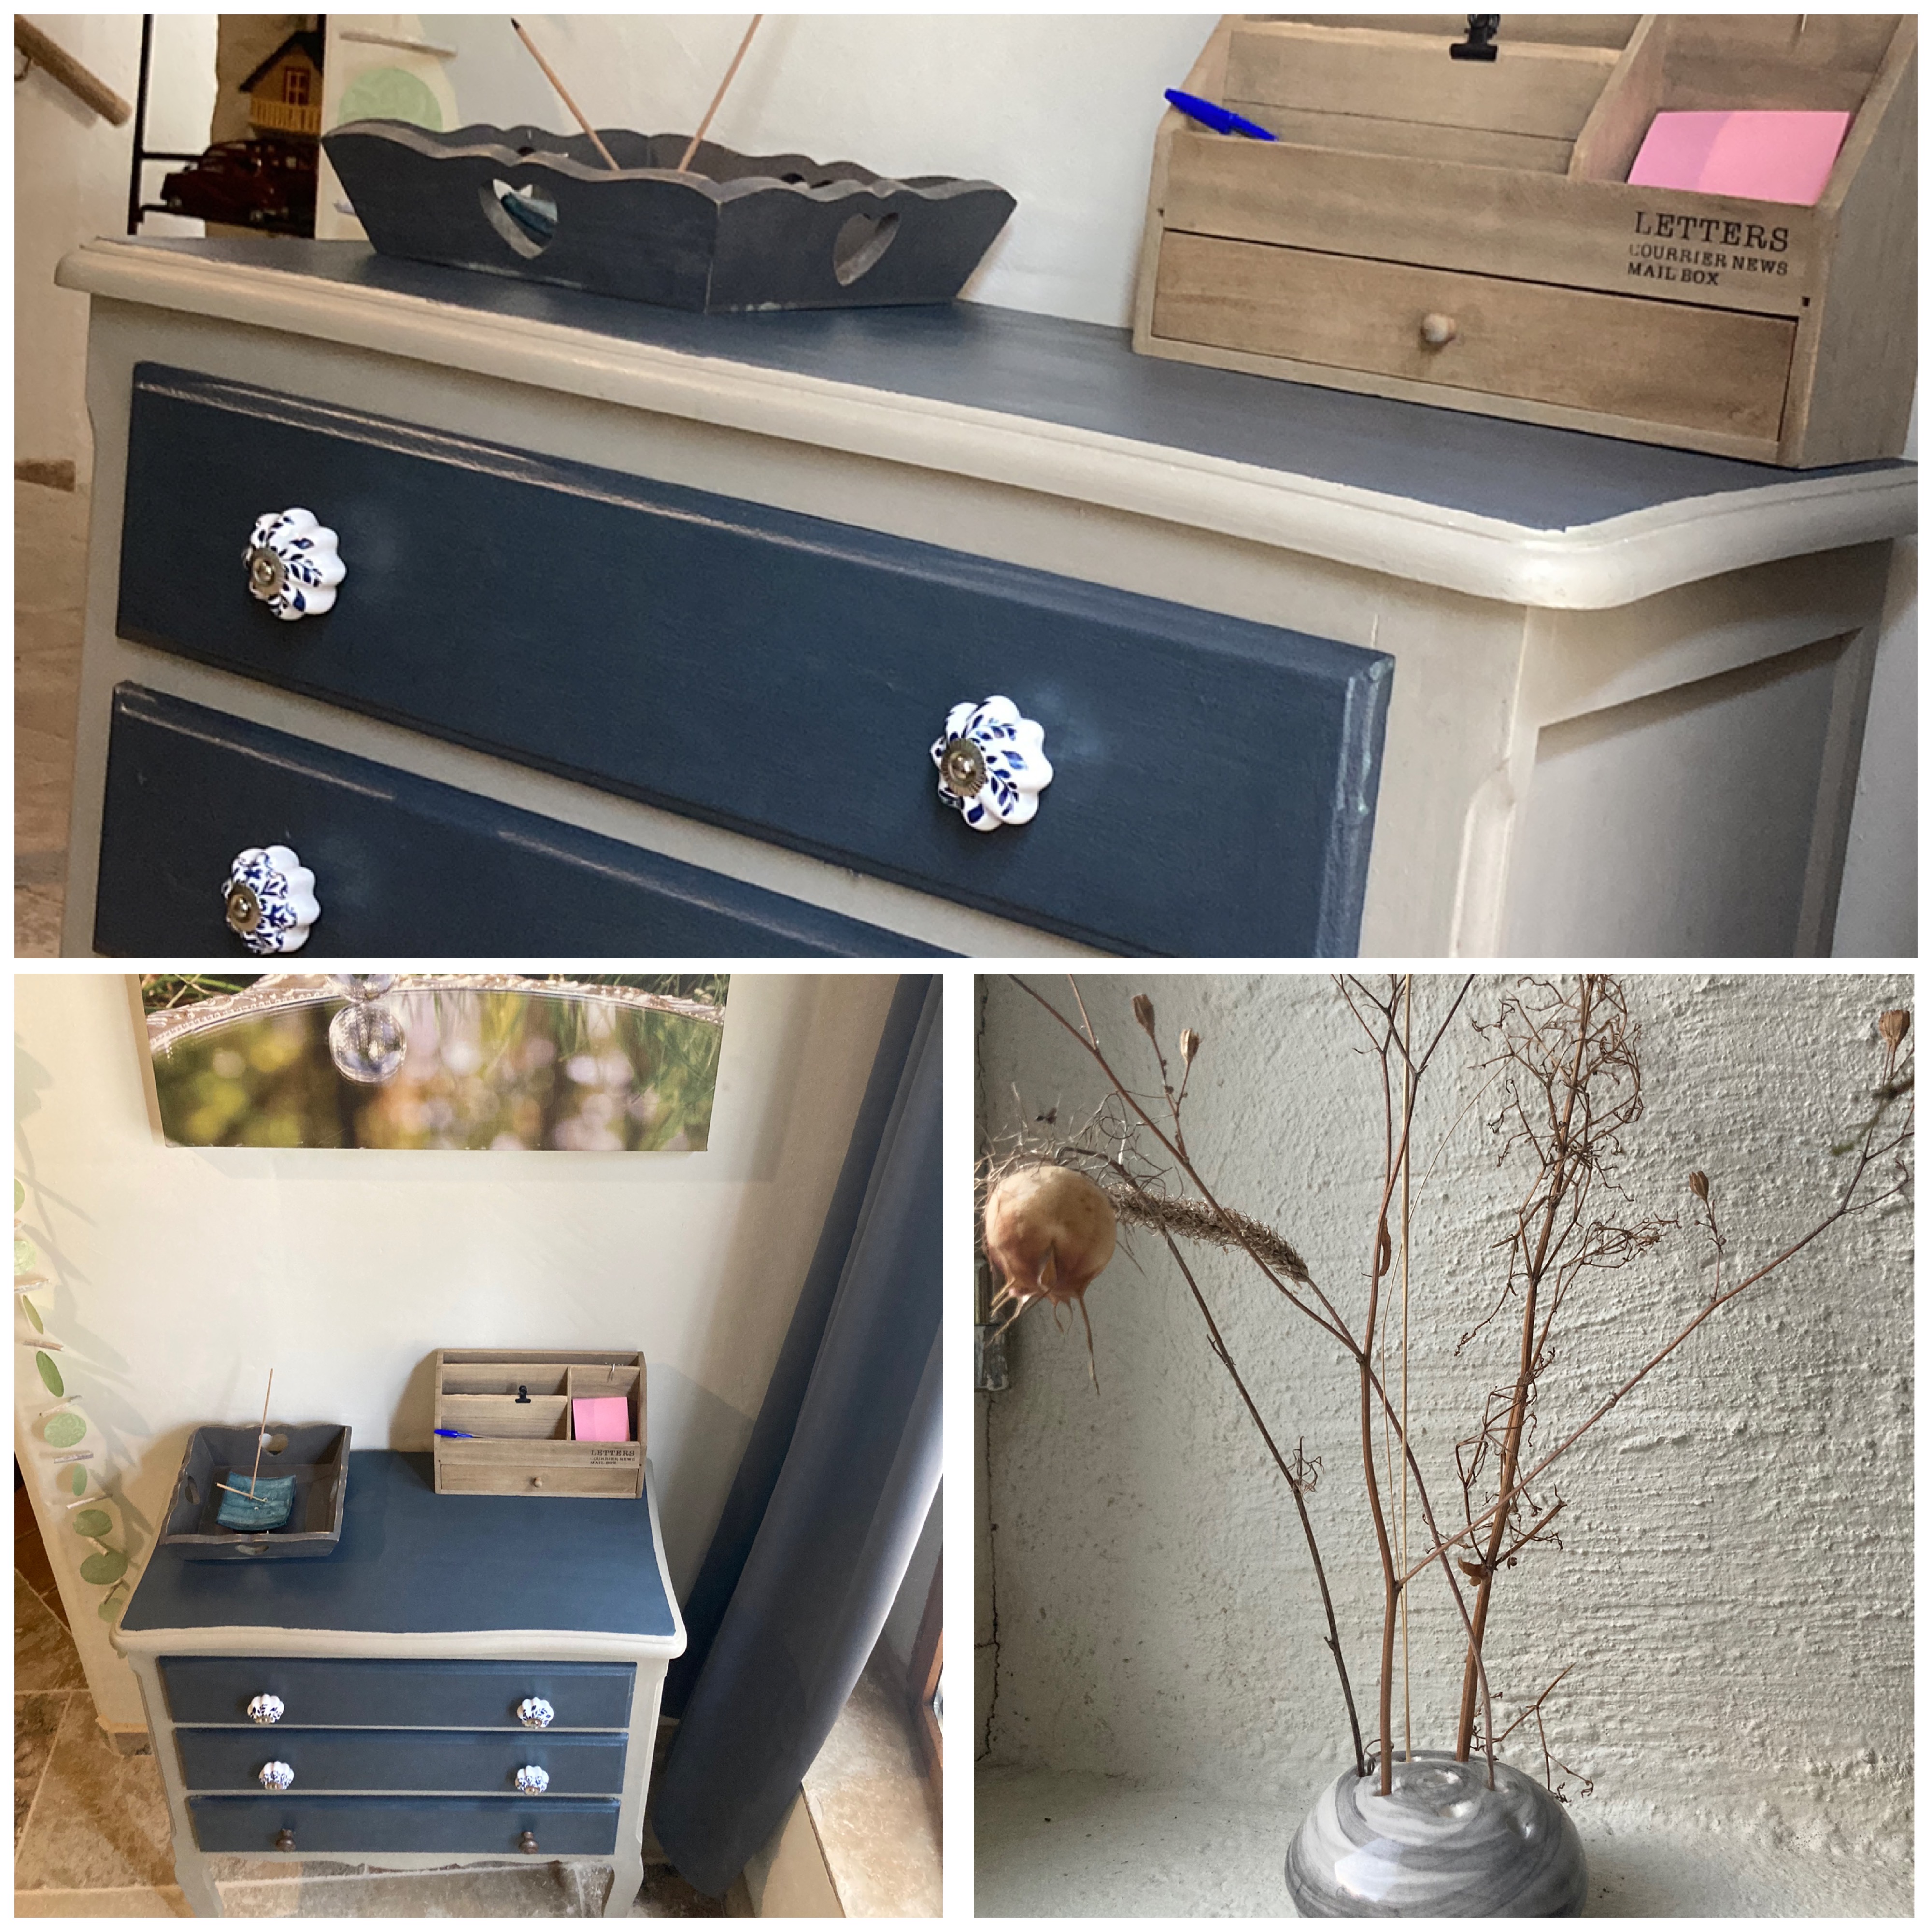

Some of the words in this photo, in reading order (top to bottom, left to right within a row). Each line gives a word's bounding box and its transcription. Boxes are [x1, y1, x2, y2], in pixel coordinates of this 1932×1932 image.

[1635, 211, 1789, 252] LETTERS
[1627, 261, 1676, 281] MAIL
[1680, 268, 1719, 286] BOX
[1629, 243, 1728, 268] COURRIER
[1732, 255, 1788, 276] NEWS
